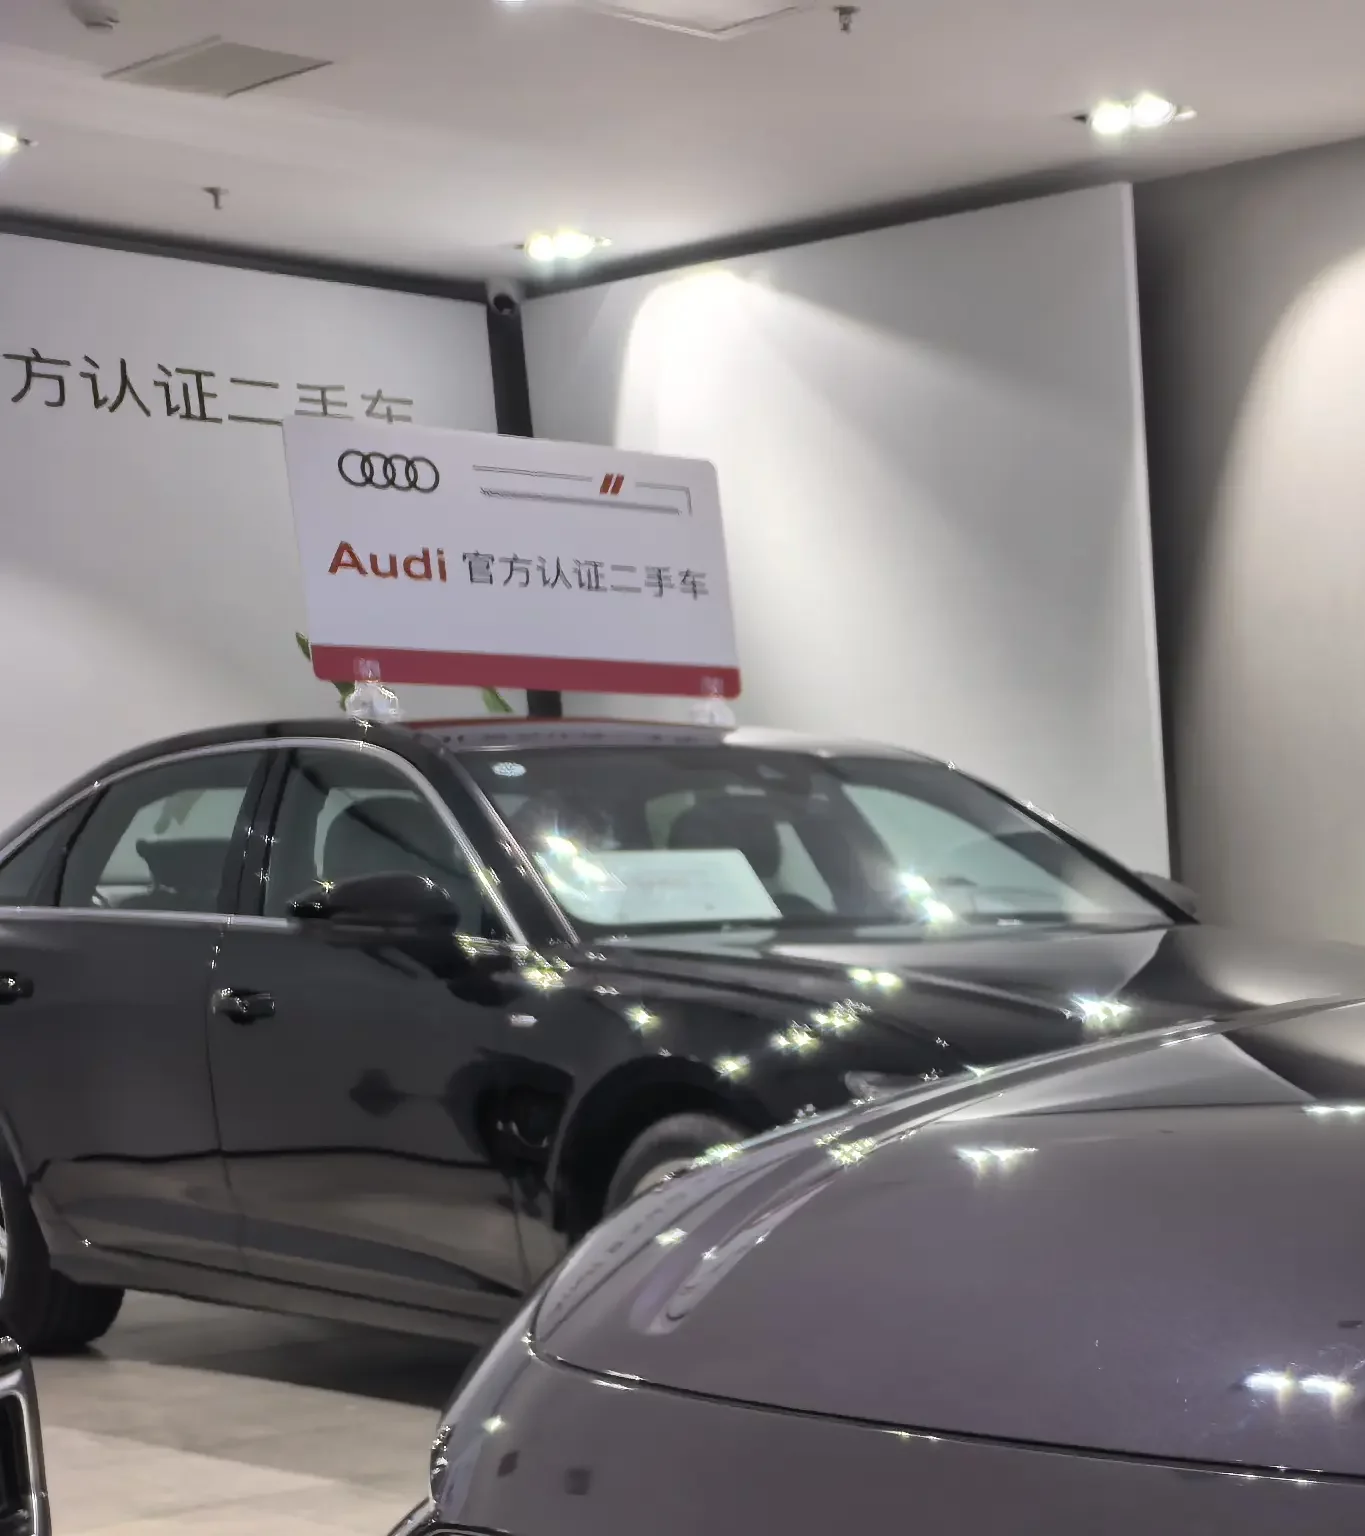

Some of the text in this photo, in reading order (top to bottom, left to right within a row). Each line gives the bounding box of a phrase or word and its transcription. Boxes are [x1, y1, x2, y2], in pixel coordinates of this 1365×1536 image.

[328, 541, 709, 600] Audi 官方认证二手车
